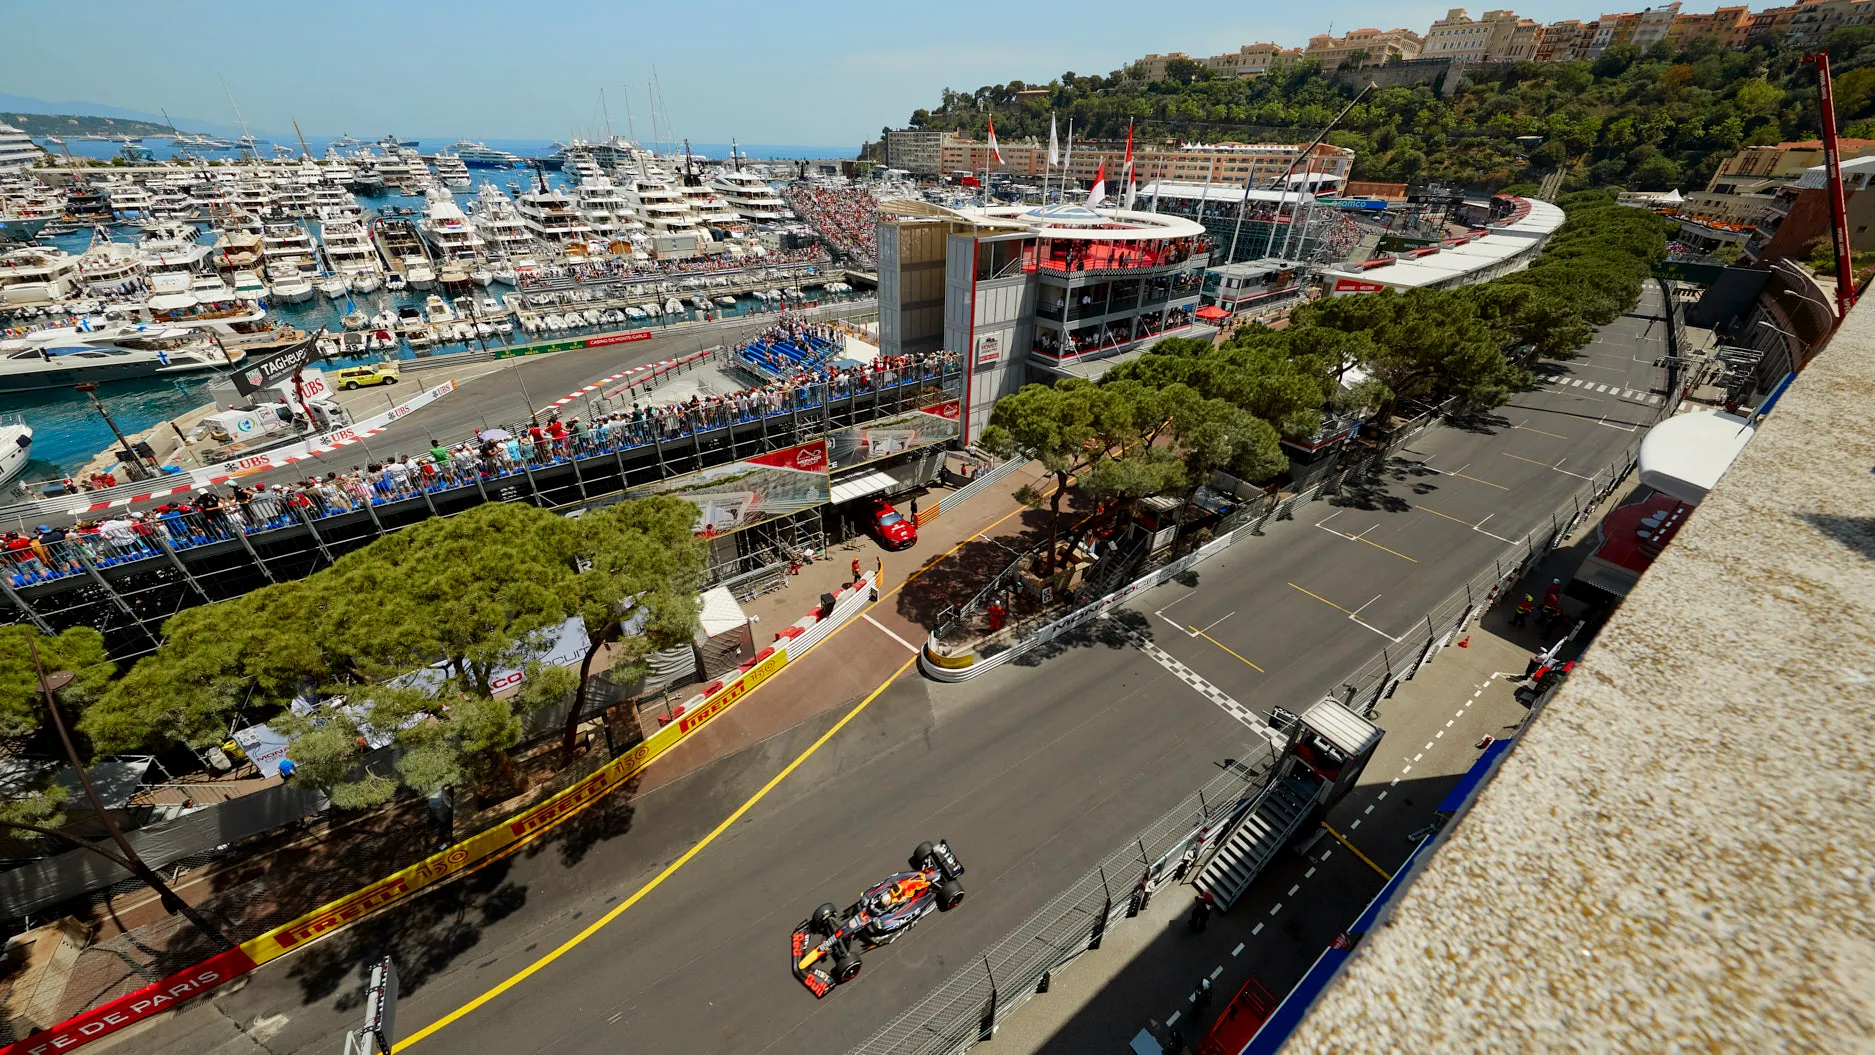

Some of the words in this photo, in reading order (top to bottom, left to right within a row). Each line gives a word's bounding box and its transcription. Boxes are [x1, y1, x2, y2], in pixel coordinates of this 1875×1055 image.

[616, 333, 648, 341] MONTE-CARLO
[301, 377, 324, 399] UBS
[437, 384, 451, 396] UBS
[394, 404, 411, 418] UBS
[331, 428, 355, 443] UBS
[239, 454, 271, 470] UBS
[1053, 585, 1136, 633] MONACO
[679, 679, 745, 735] PIRELLI
[510, 772, 608, 837] PIRELLI
[273, 877, 410, 949] PIRELLI
[792, 932, 806, 957] Red
[804, 973, 829, 998] Bull
[79, 1011, 129, 1037] DE
[129, 970, 220, 1014] PARIS
